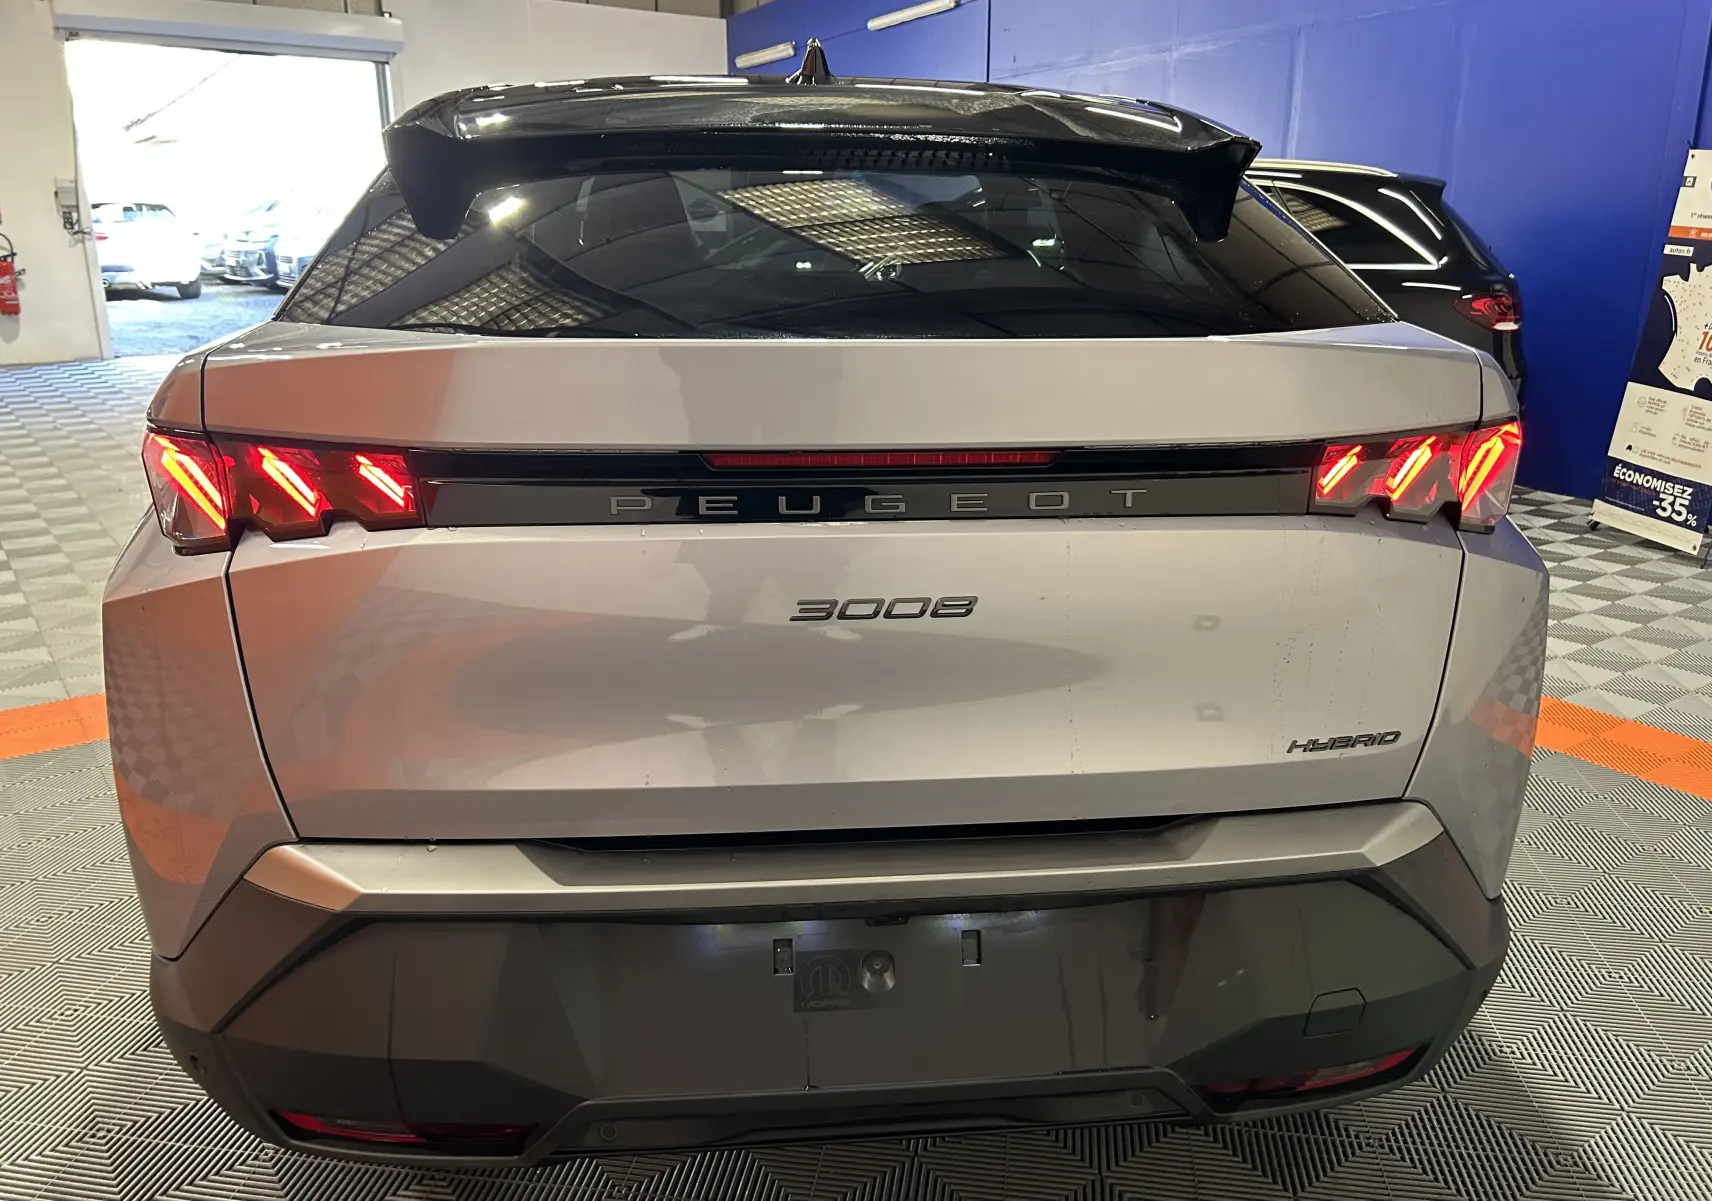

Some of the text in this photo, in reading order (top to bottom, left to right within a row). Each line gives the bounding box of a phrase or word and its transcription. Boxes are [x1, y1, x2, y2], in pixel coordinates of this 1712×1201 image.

[1613, 464, 1694, 500] ÉCONOMISEZ
[609, 487, 1148, 516] PEUGEOT
[789, 595, 979, 622] 3008
[1286, 730, 1402, 754] HYBRID
